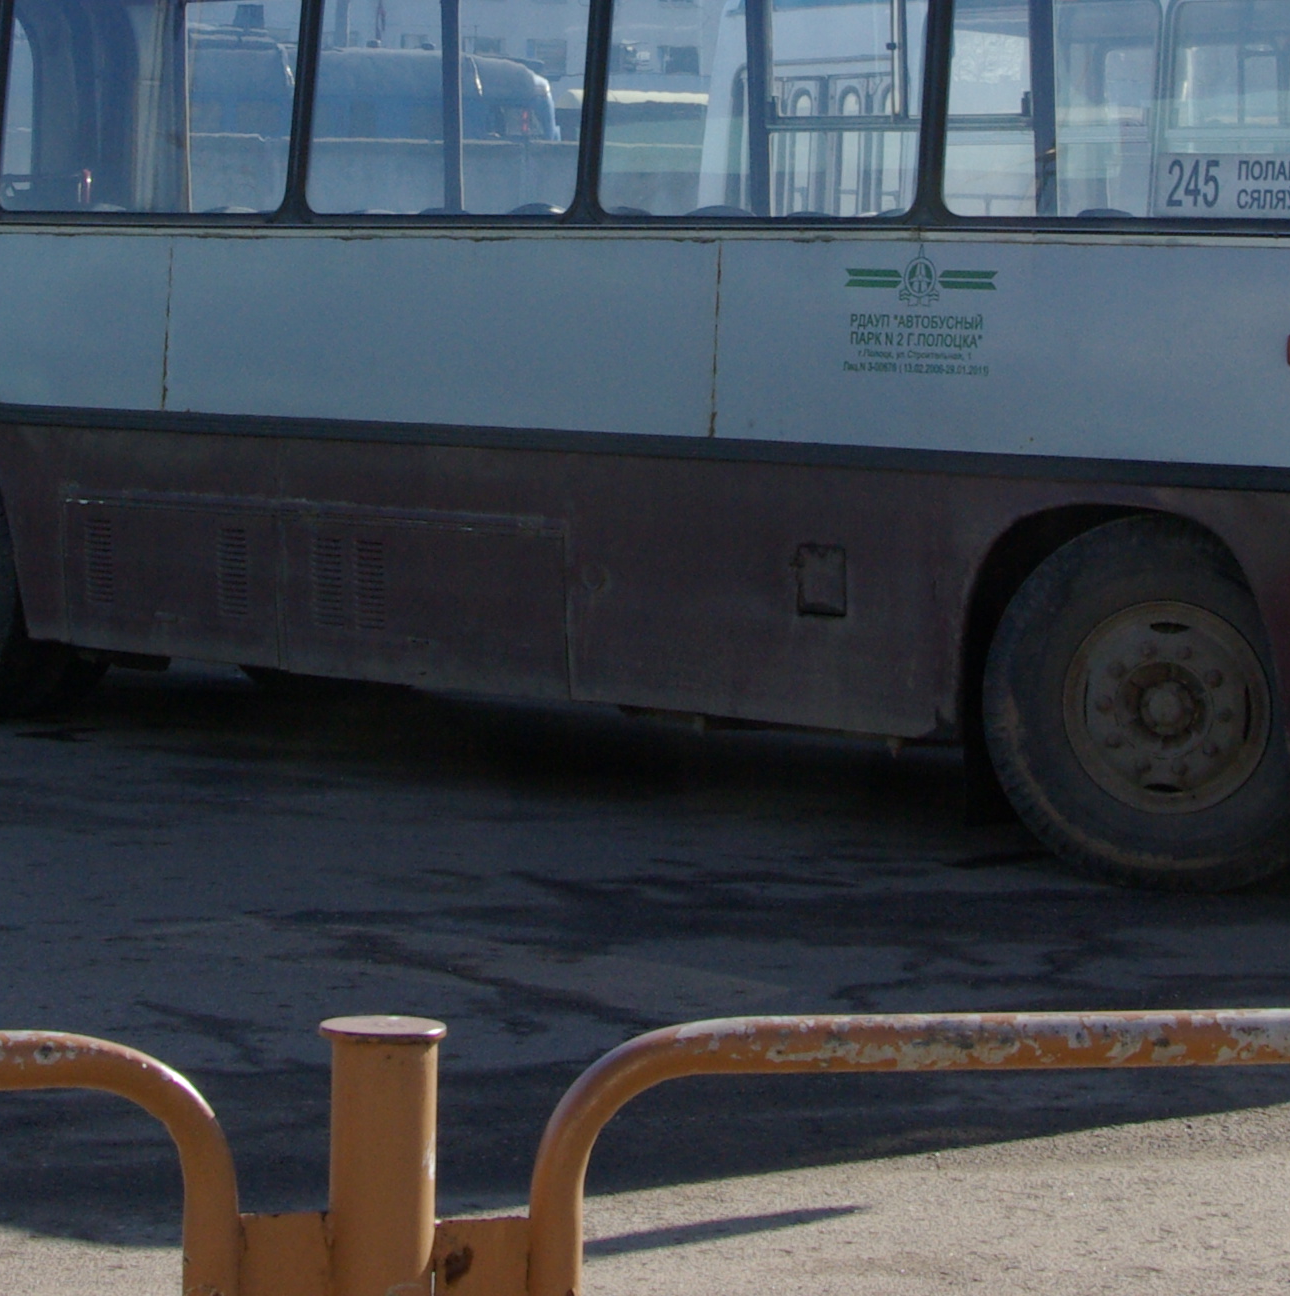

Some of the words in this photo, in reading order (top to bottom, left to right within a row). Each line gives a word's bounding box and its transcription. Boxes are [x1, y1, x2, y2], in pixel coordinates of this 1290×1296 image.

[1166, 159, 1220, 207] 245
[850, 313, 890, 330] РДАУП
[893, 313, 983, 330] "АВТОБУСНЫЙ
[850, 331, 882, 345] ПАРК
[885, 332, 893, 345] N
[897, 333, 904, 346] 2
